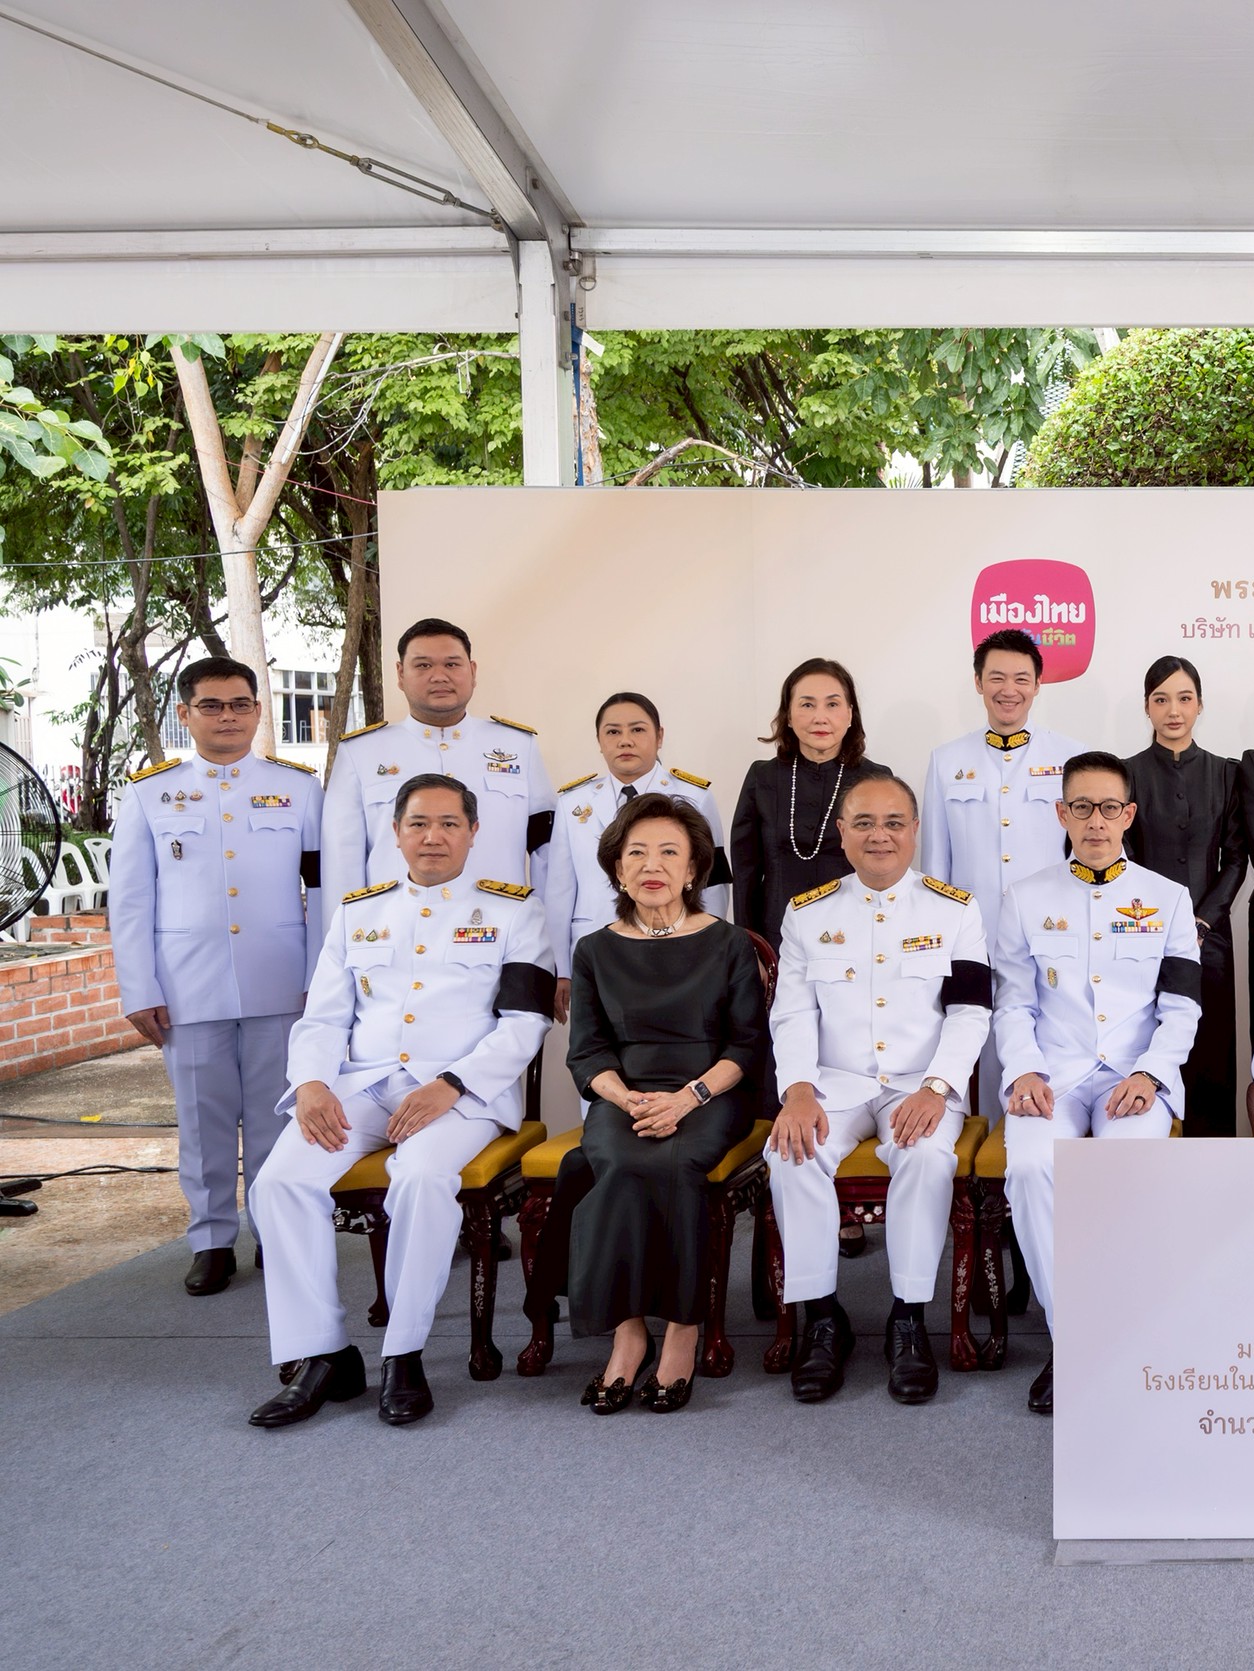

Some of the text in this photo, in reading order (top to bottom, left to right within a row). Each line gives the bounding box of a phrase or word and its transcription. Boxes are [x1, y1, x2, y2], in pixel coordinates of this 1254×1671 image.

[980, 592, 1086, 624] เมืองไทย
[1180, 616, 1241, 639] บริษัท
